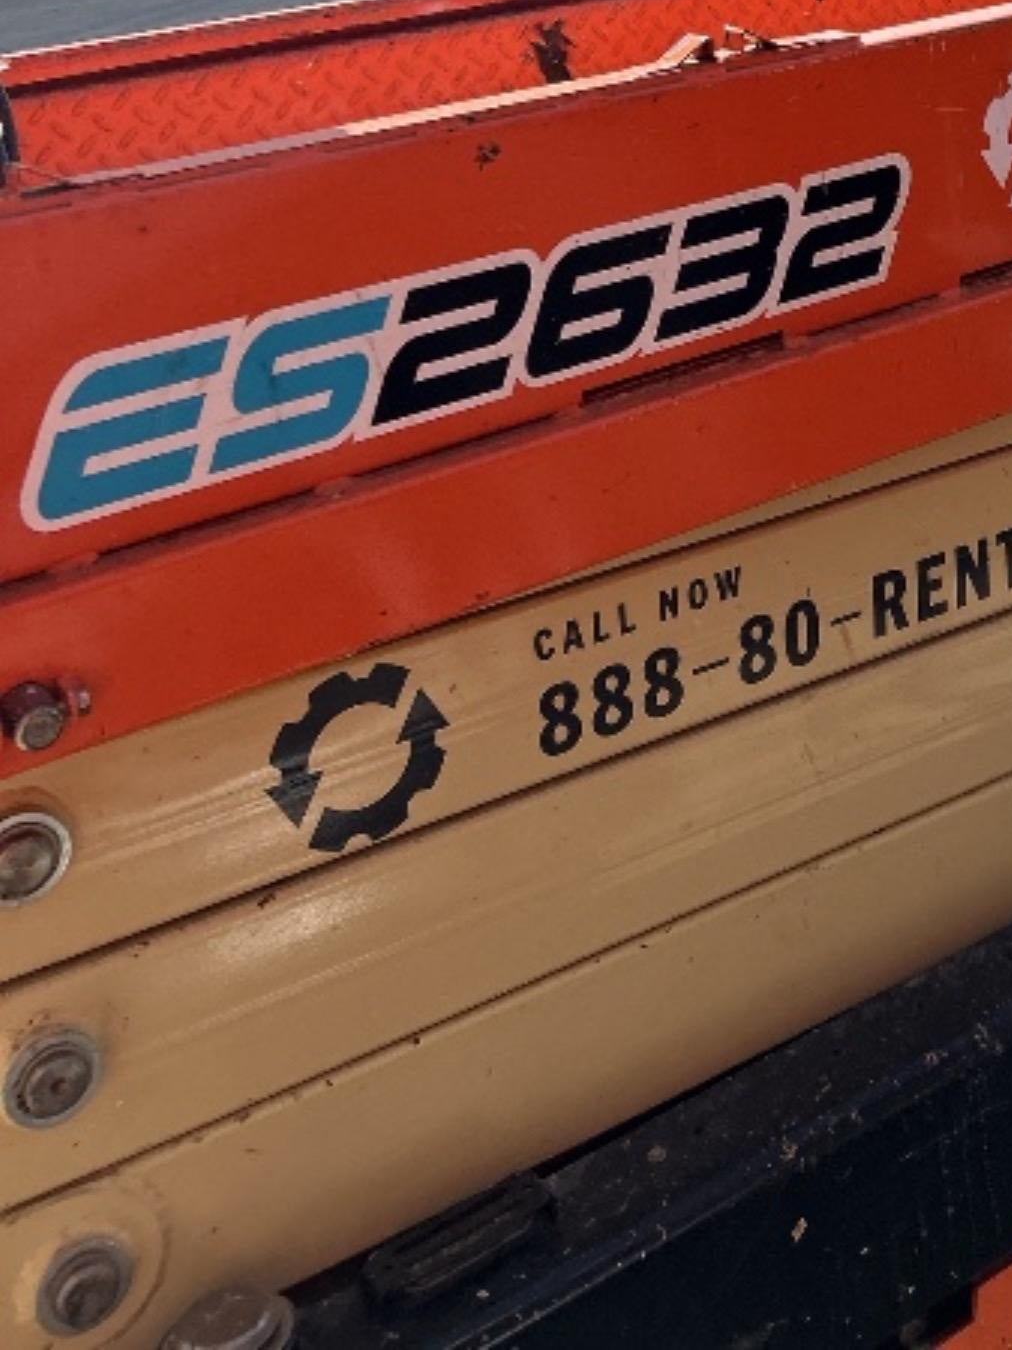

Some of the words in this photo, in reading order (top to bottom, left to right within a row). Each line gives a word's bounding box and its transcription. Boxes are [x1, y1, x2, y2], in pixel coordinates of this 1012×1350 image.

[21, 153, 911, 532] ES2632
[532, 602, 638, 661] CALL
[657, 565, 743, 622] NOW
